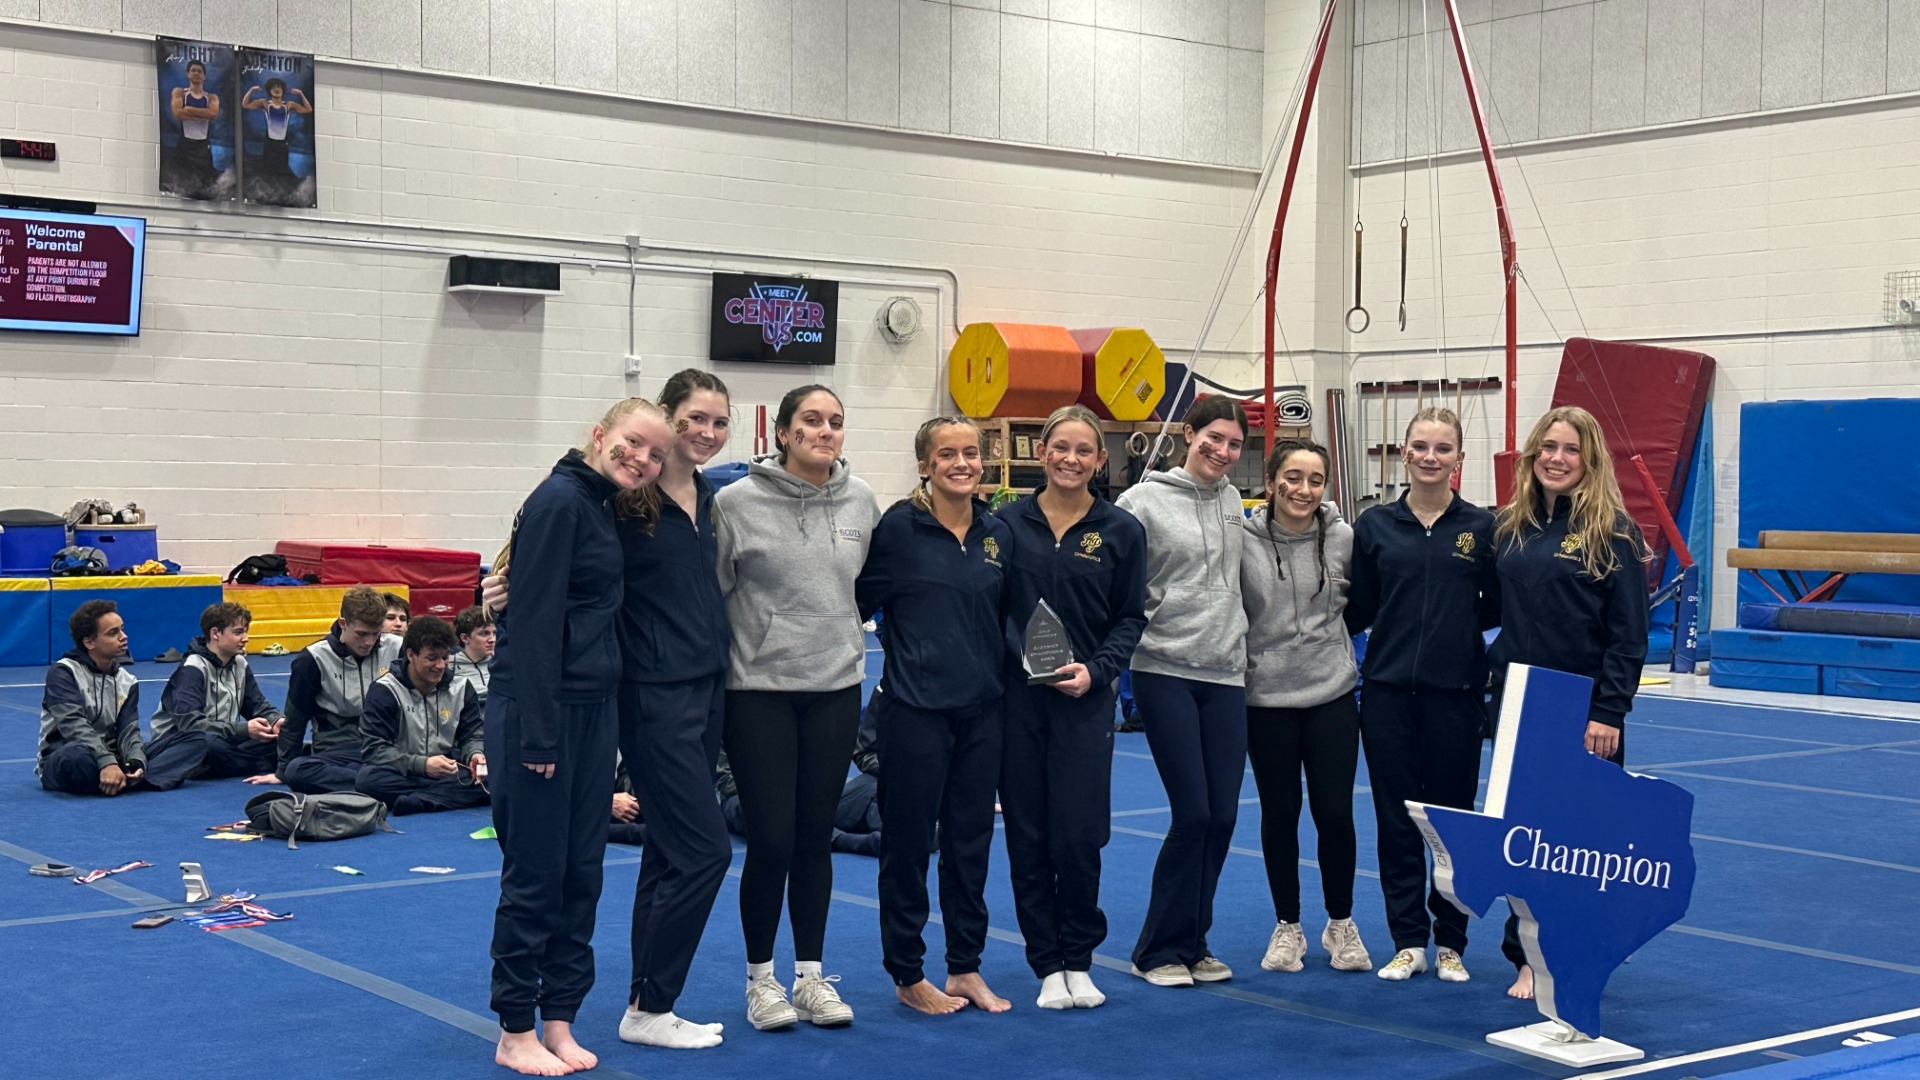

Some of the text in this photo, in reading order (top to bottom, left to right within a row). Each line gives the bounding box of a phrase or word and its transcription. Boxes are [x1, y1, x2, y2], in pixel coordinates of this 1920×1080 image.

[25, 223, 86, 239] Welcome
[27, 237, 83, 252] Parents!
[27, 257, 108, 269] PARENTS ARE NOT ALLOWED
[27, 266, 107, 278] ON THE COMPETITION FLOOR
[26, 274, 34, 282] AT
[35, 275, 48, 283] ANY
[48, 276, 66, 284] POINT
[89, 278, 101, 287] THE
[25, 292, 97, 304] NO FLASH PHOTOGRAPHY
[768, 288, 790, 298] MEET
[724, 297, 825, 329] CENTER
[762, 321, 793, 345] US
[1502, 825, 1672, 892] Champion
